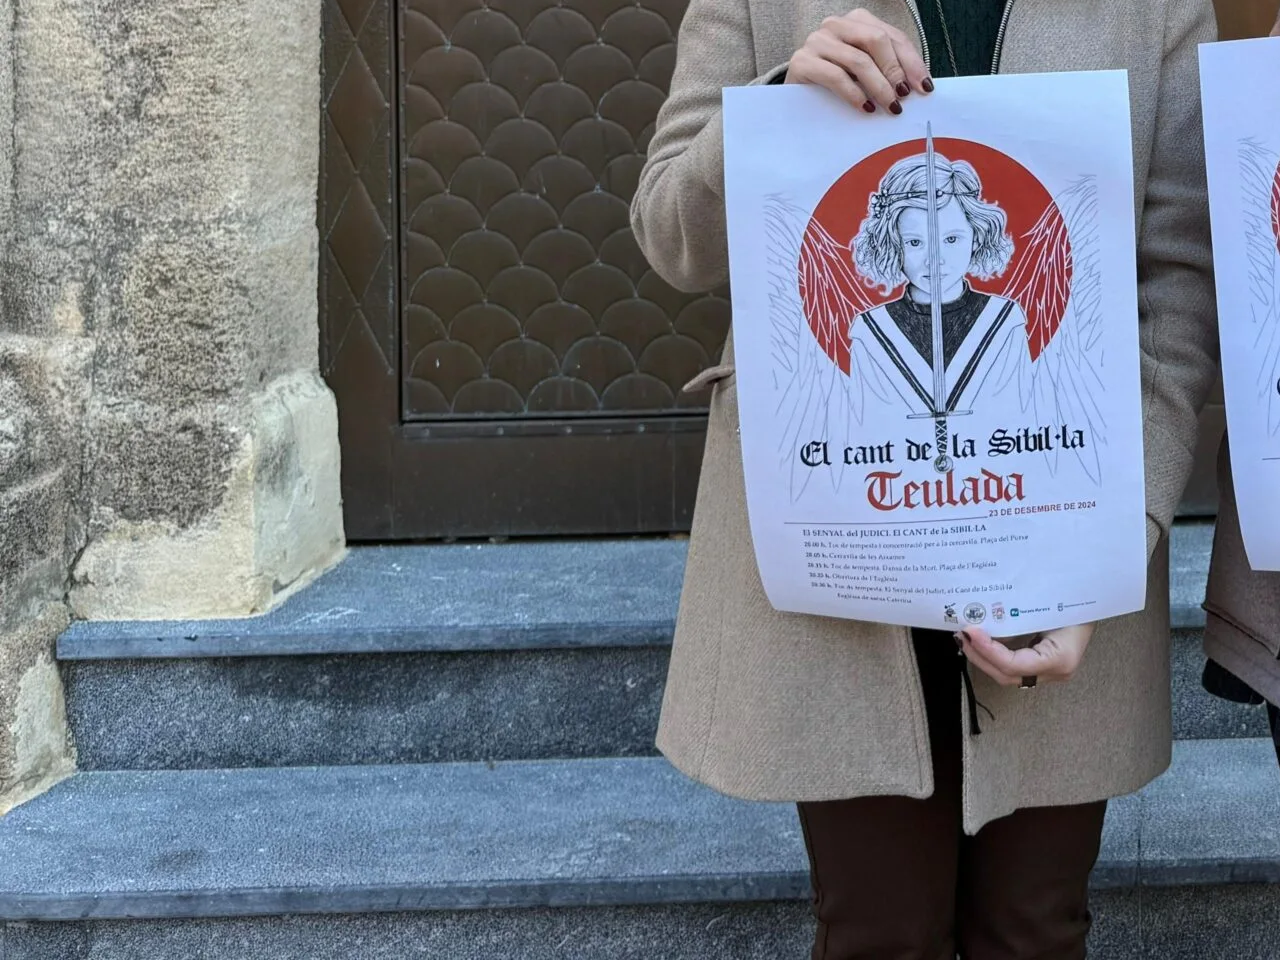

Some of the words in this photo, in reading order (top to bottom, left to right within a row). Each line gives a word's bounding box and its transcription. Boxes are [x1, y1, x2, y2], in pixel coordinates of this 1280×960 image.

[800, 440, 831, 467] El
[843, 440, 894, 465] cant
[906, 439, 932, 461] de
[952, 434, 976, 458] la
[988, 425, 1085, 458] Sibil·la
[864, 468, 1026, 511] Teulada
[989, 509, 998, 517] 23
[1000, 508, 1012, 516] DE
[1014, 503, 1062, 515] DESEMBRE
[1064, 502, 1075, 510] DE
[1077, 501, 1096, 509] 2024
[803, 529, 810, 537] El
[812, 529, 845, 537] SENYAL
[893, 529, 901, 537] El
[902, 528, 928, 537] CANT
[930, 527, 940, 535] de
[941, 527, 949, 535] la
